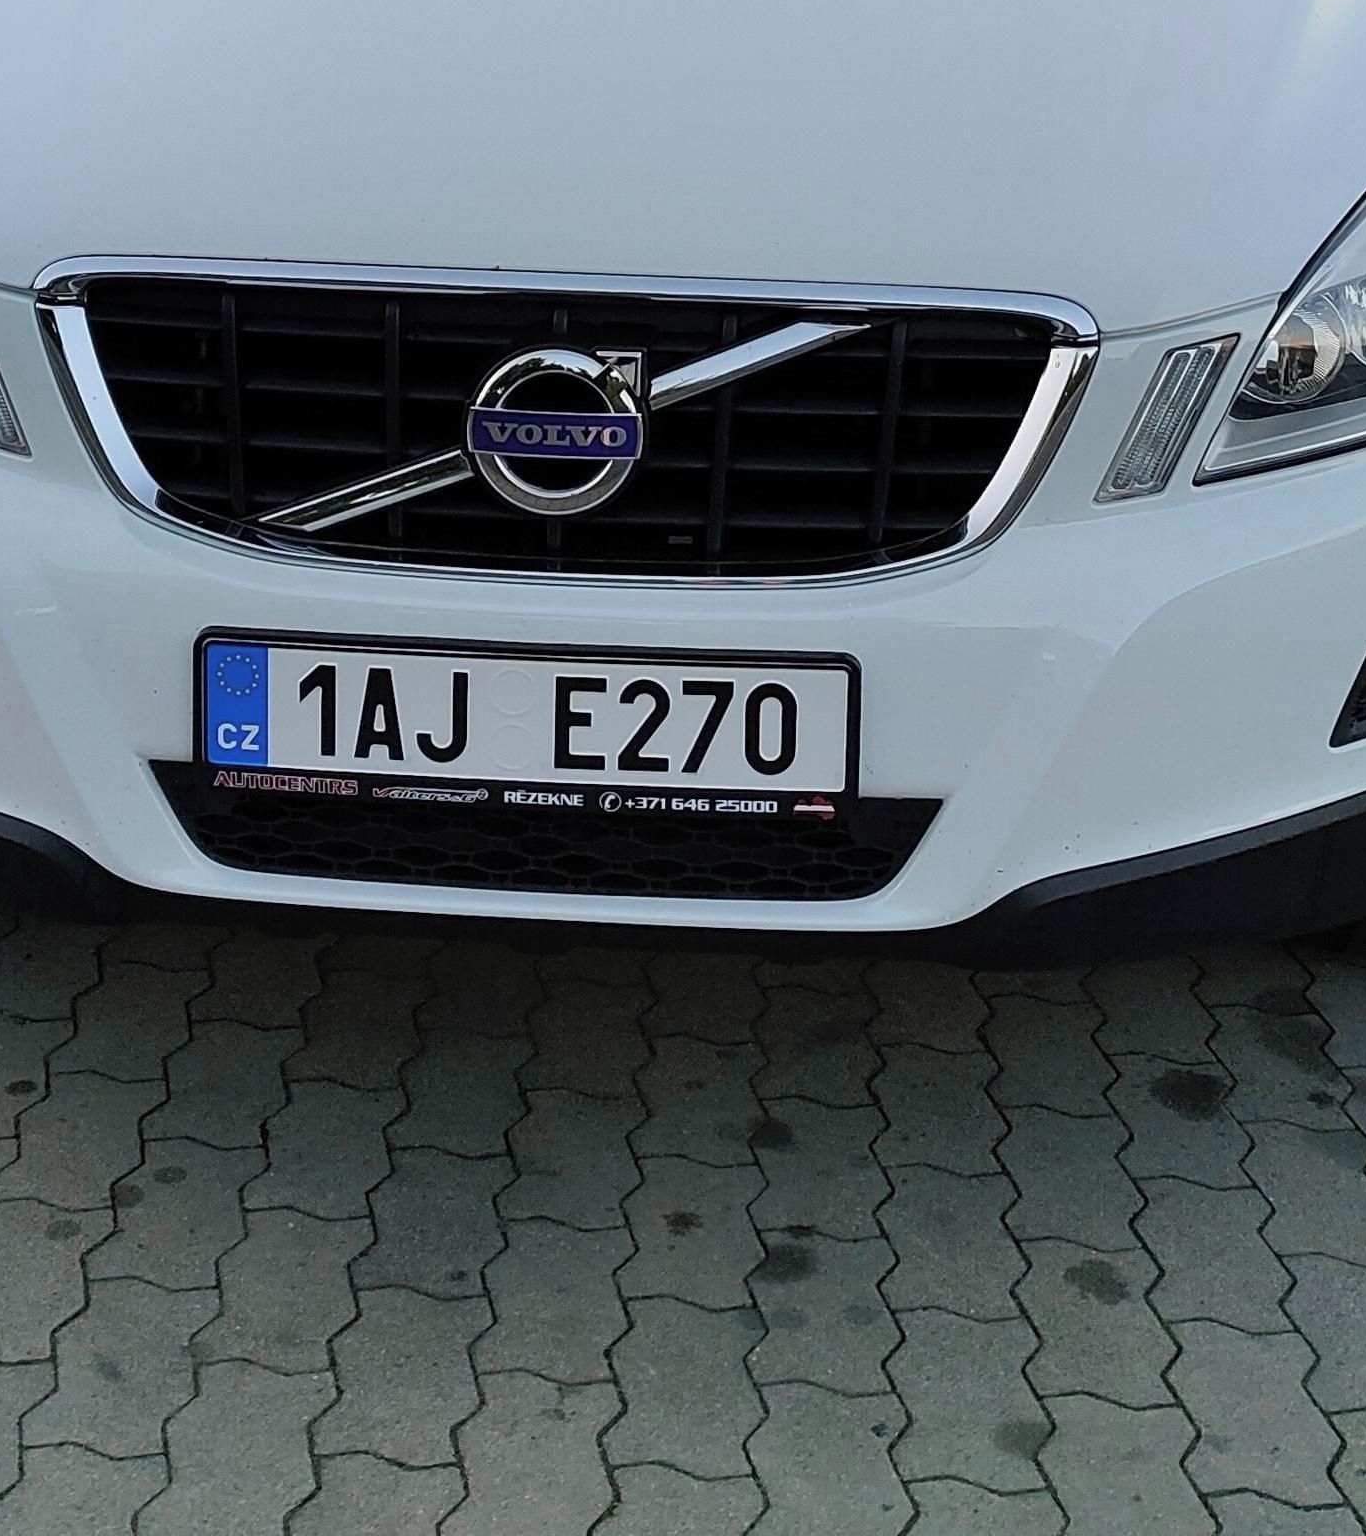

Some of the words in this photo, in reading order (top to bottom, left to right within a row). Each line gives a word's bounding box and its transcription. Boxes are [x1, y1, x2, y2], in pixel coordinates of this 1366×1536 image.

[482, 421, 627, 447] VOLVO
[217, 722, 260, 751] CZ
[299, 663, 469, 763] 1AJ
[553, 675, 798, 776] E270
[213, 770, 359, 796] AUTOCENTRS
[503, 789, 584, 807] RĒZEKNE
[624, 796, 666, 811] +371
[671, 797, 710, 811] 646
[715, 799, 778, 814] 25000
